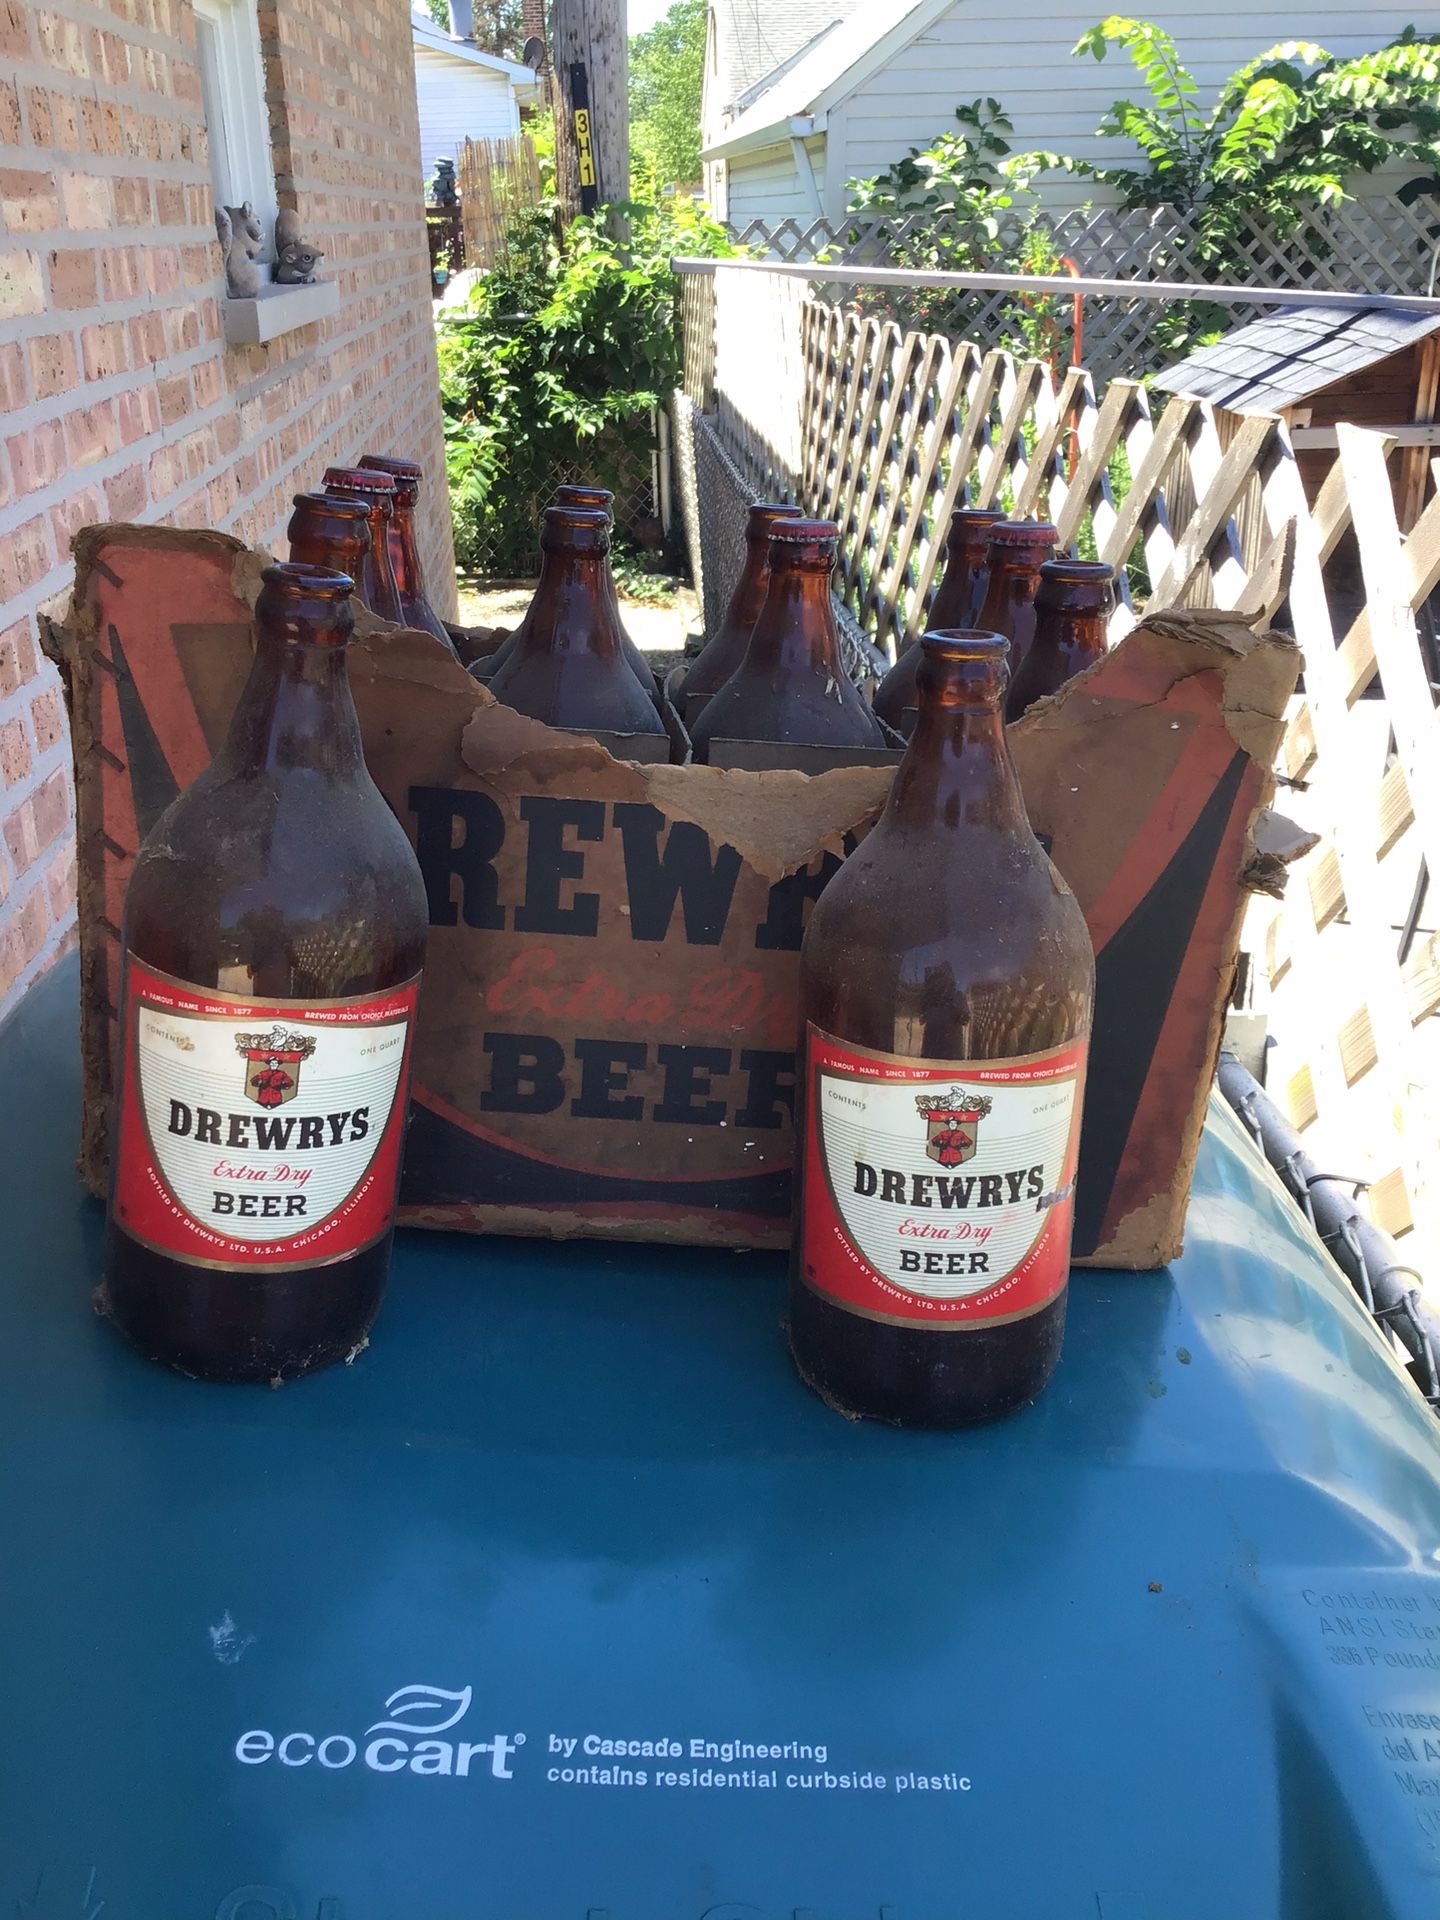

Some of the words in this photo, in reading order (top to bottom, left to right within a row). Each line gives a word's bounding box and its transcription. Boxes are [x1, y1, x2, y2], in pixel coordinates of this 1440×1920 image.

[577, 113, 592, 184] 3H1
[486, 947, 673, 1024] Extra
[149, 993, 174, 1006] FAMOUS
[178, 1000, 199, 1011] NAME
[204, 1005, 227, 1015] SINCE
[233, 1007, 253, 1016] 1877
[304, 1011, 337, 1020] BREWED
[338, 1011, 359, 1020] FROM
[361, 1010, 384, 1020] CHOICE
[384, 1005, 409, 1016] MATERIALS
[360, 1047, 377, 1056] ONE
[379, 1037, 401, 1051] QUART
[830, 1060, 855, 1072] FAMOUS
[859, 1066, 879, 1076] NAME
[885, 1070, 906, 1078] SINCE
[980, 1072, 1010, 1080] BREWED
[1032, 1068, 1054, 1078] CHOICE
[828, 1090, 867, 1110] CONTENTS
[1032, 1106, 1048, 1114] ONE
[168, 1098, 370, 1150] DREWRYS
[212, 1160, 269, 1181] Extra
[269, 1164, 313, 1189] Dry
[853, 1161, 1044, 1209] DREWRYS
[147, 1167, 171, 1205] BOTTLED
[171, 1207, 183, 1218] BY
[183, 1219, 225, 1247] DREWRYS
[229, 1243, 250, 1253] LTD.
[254, 1246, 286, 1254] U.S.A.
[343, 1175, 375, 1216] ILLINOIS
[212, 1191, 307, 1217] BEER
[897, 1218, 950, 1239] Extra
[952, 1221, 993, 1247] Dry
[833, 1227, 859, 1263] BOTTLED
[859, 1264, 871, 1276] BY
[871, 1276, 912, 1304] DREWRYS
[917, 1300, 936, 1310] LTD.
[940, 1303, 970, 1311] U.S.A.
[1022, 1233, 1050, 1273] ILLINOIS
[900, 1249, 989, 1275] BEER
[1302, 1588, 1420, 1611] Container
[1320, 1616, 1386, 1638] ANSI
[1364, 1646, 1440, 1670] Pound
[548, 1734, 577, 1758] by
[583, 1734, 683, 1757] Cascade
[690, 1738, 828, 1763] Engineering
[1382, 1736, 1418, 1762] del
[1423, 1738, 1440, 1763] A
[547, 1765, 648, 1786] contains
[656, 1768, 777, 1788] residential
[786, 1771, 887, 1790] curbside
[896, 1772, 971, 1793] plastic
